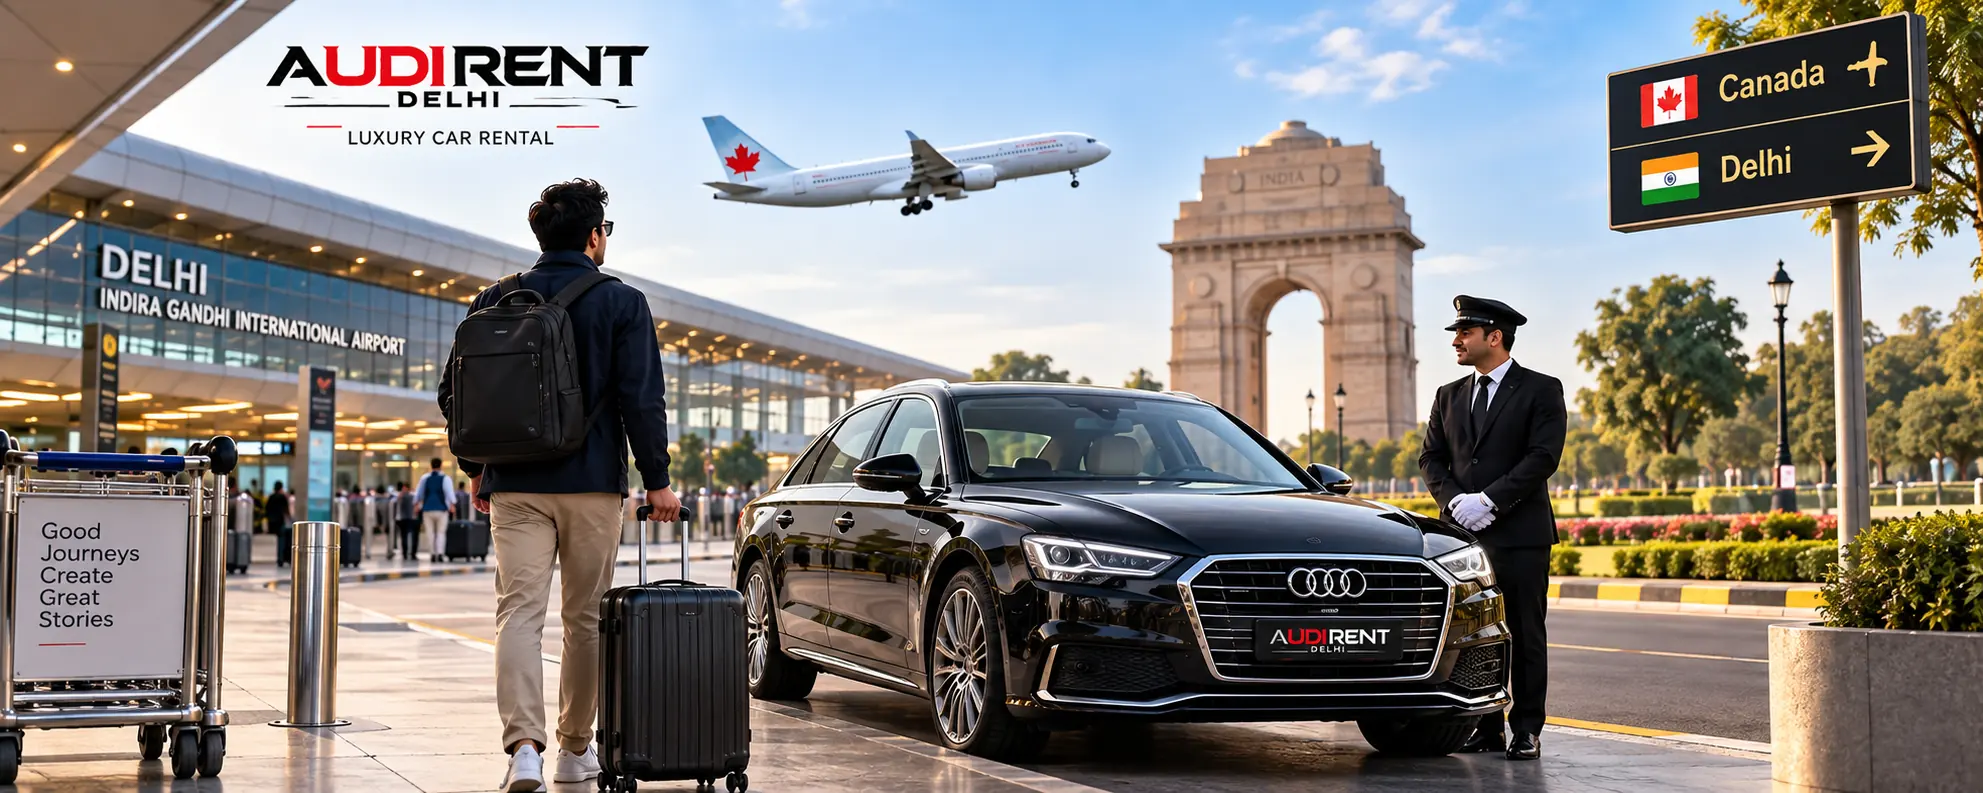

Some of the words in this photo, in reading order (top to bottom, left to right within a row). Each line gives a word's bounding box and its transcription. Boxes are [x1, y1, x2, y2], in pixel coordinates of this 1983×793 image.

[1719, 60, 1825, 102] Canada
[1721, 145, 1791, 183] Delhi
[1260, 169, 1305, 187] INDIA
[101, 243, 208, 295] DELHI
[100, 287, 162, 318] INDIRA
[166, 298, 231, 328] GANDHI
[235, 310, 349, 347] INTERNATIONAL
[352, 330, 406, 356] AIRPORT
[41, 522, 101, 540] Good
[40, 544, 140, 565] Journeys
[40, 566, 113, 584] Create
[39, 588, 100, 606] Great
[39, 610, 114, 628] Stories
[1270, 628, 1390, 645] AUDIRENT
[1311, 645, 1345, 653] DELHI
